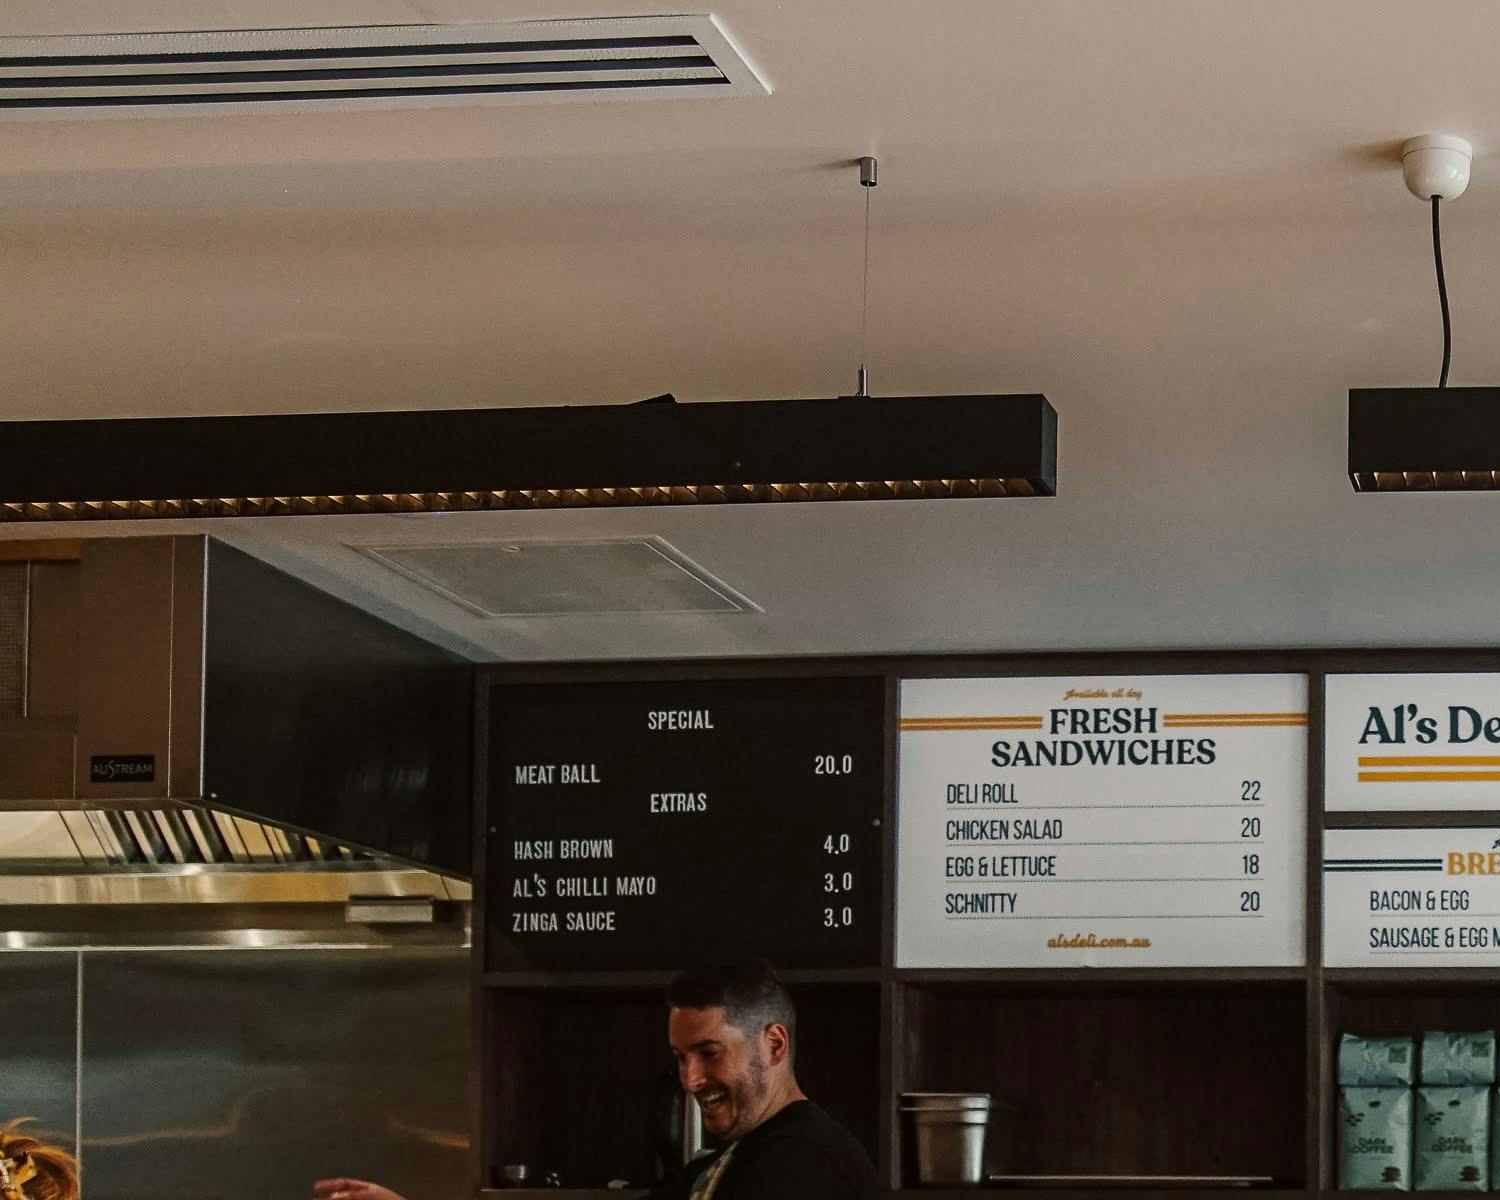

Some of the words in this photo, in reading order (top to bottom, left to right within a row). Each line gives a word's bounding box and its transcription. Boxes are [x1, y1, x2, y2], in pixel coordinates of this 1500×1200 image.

[648, 711, 714, 730] SPECIAL
[1050, 707, 1157, 735] FRESH
[1358, 703, 1437, 744] Al's
[991, 738, 1217, 767] SANDWICHES
[515, 765, 555, 784] MEAT
[561, 764, 600, 783] BALL
[815, 755, 853, 775] 20.0
[946, 784, 979, 804] DELI
[982, 784, 1018, 803] ROLL
[1241, 781, 1261, 801] 22
[650, 793, 707, 813] EXTRAS
[946, 820, 1010, 840] CHICKEN
[1013, 820, 1063, 840] SALAD
[1241, 818, 1261, 838] 20
[514, 840, 553, 860] HASH
[560, 839, 614, 859] BROWN
[823, 834, 850, 854] 4.0
[945, 857, 974, 877] EGG
[978, 856, 988, 876] &
[992, 856, 1057, 876] LETTUCE
[1242, 855, 1259, 875] 18
[513, 873, 546, 898] AL'S
[557, 877, 608, 897] CHILLI
[616, 877, 656, 895] MAYO
[824, 872, 853, 892] 3.0
[945, 893, 1017, 914] SCHNITTY
[1240, 892, 1260, 912] 20
[1370, 890, 1422, 911] BACON
[1426, 890, 1436, 910] &
[1440, 890, 1470, 910] EGG
[512, 912, 558, 932] ZINGA
[566, 912, 616, 931] SAUCE
[824, 907, 853, 927] 3.0
[1370, 927, 1440, 948] SAUSAGE
[1445, 927, 1455, 948] &
[1459, 927, 1489, 948] EGG
